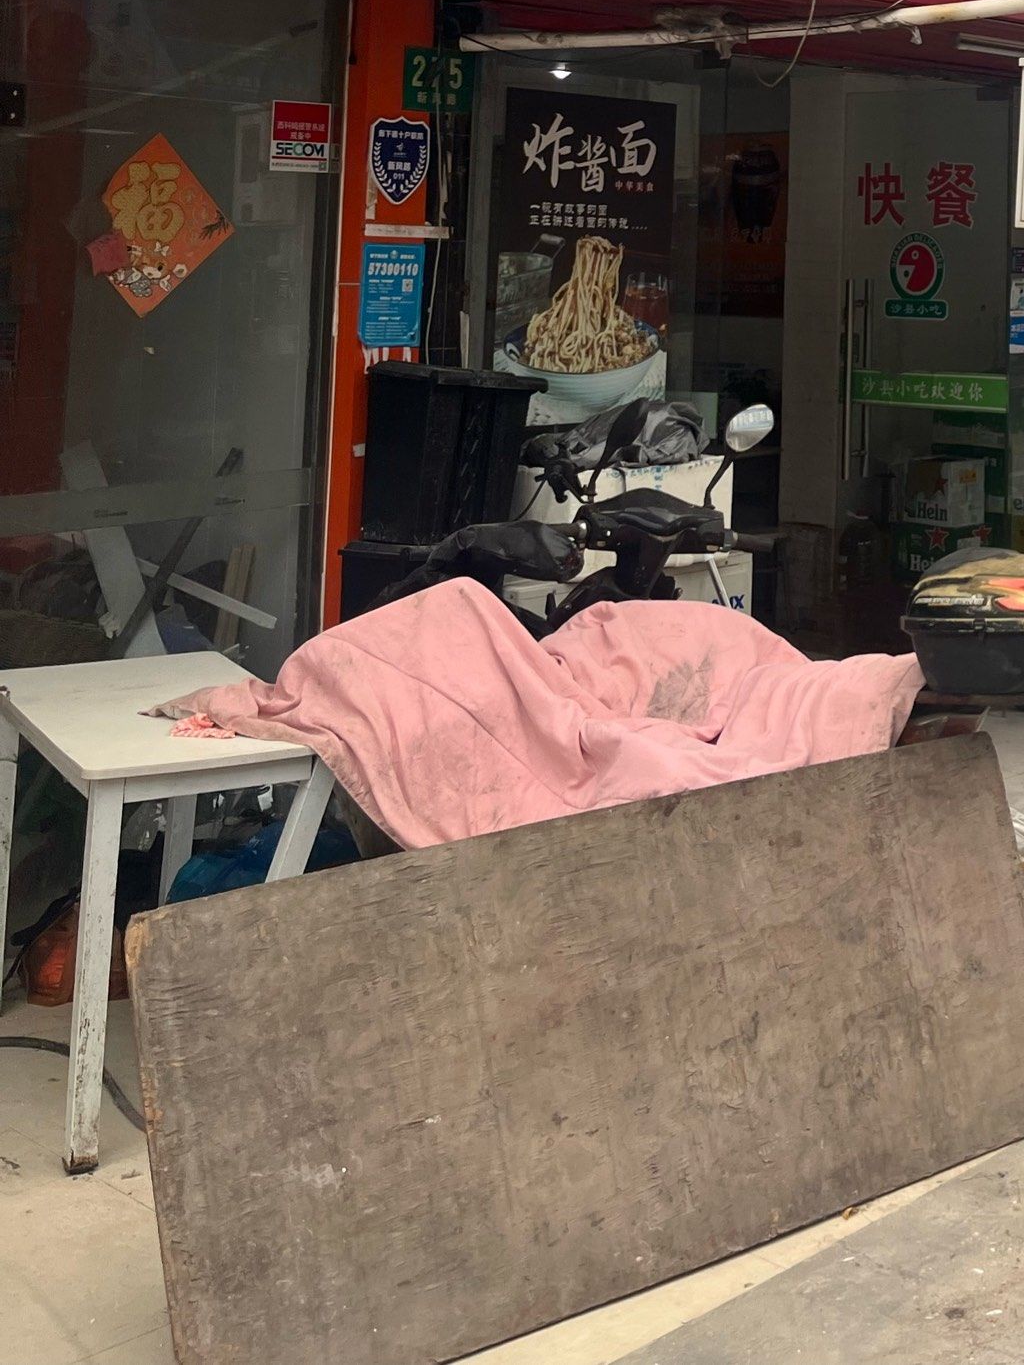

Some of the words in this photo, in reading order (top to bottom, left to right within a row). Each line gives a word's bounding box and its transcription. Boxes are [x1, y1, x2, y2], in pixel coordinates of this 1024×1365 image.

[275, 142, 325, 158] SECOM
[522, 112, 657, 193] 炸酱面
[111, 161, 185, 243] 福
[857, 161, 978, 229] 快餐
[889, 303, 943, 316] 沙县小吃
[861, 376, 985, 402] 沙县小吃欢迎你
